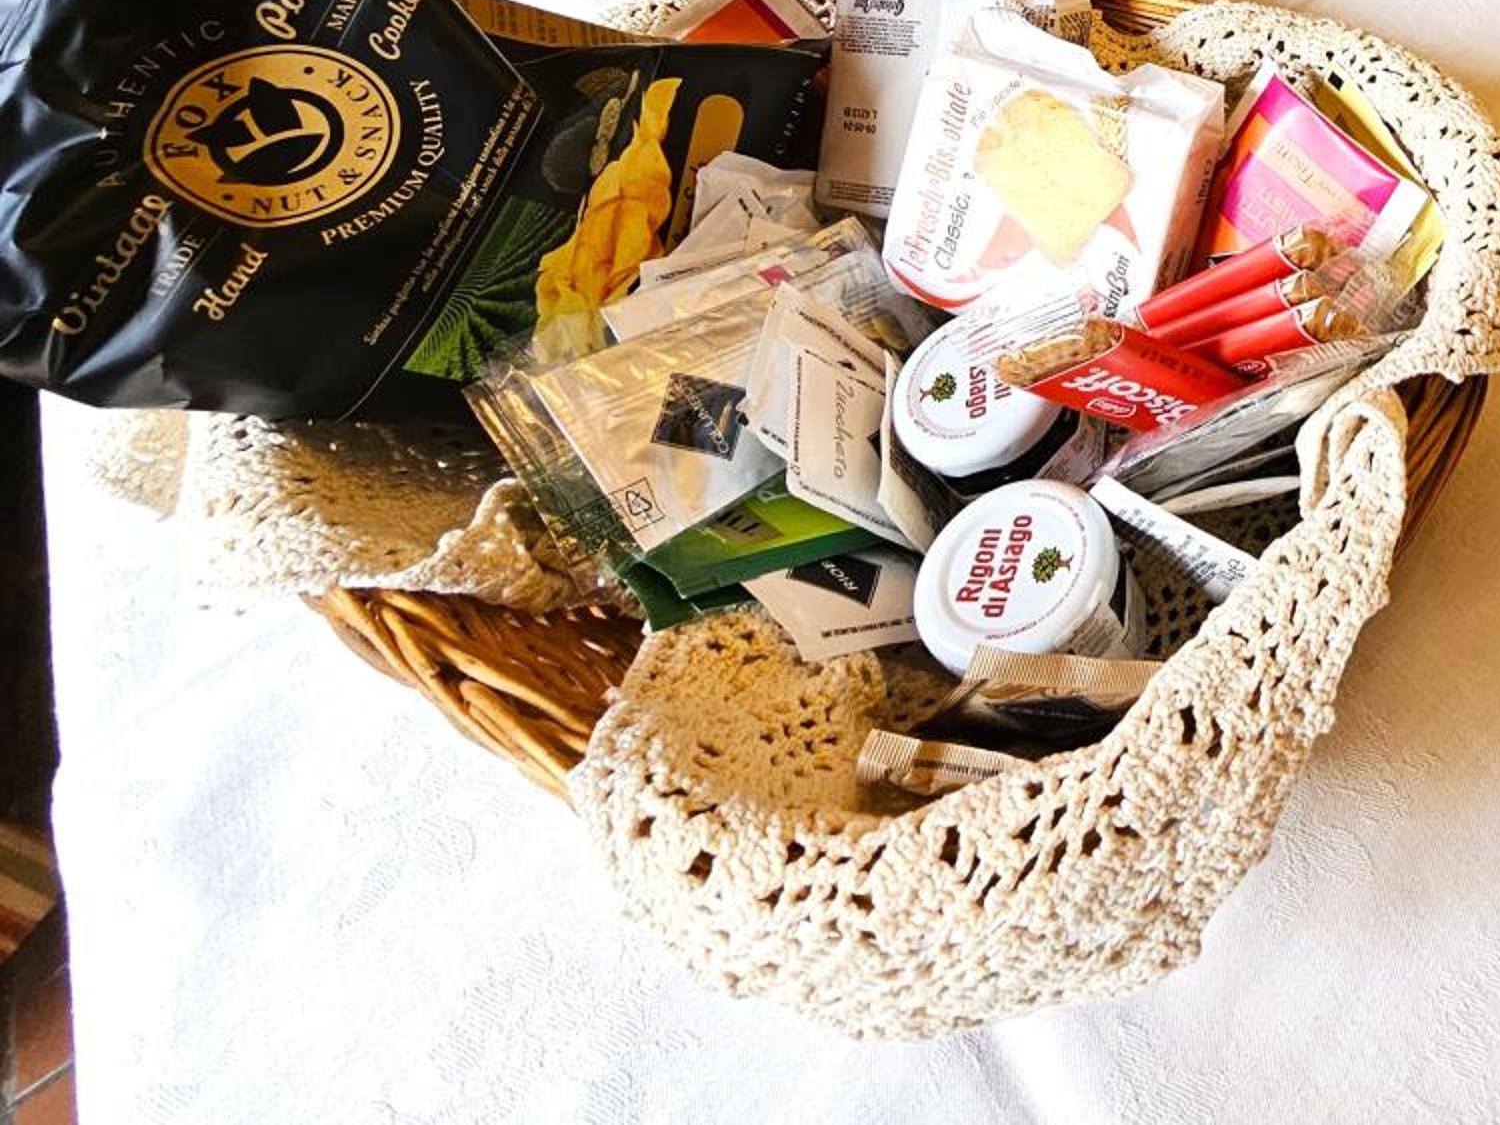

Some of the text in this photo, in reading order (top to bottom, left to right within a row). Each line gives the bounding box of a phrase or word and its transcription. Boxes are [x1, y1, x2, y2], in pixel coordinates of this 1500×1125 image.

[95, 18, 226, 190] AUTHENTIC
[163, 71, 244, 161] FOX
[252, 68, 386, 216] NUT & SNACK
[320, 79, 445, 246] PREMIUM QUALITY
[52, 194, 174, 335] Vintage
[152, 233, 206, 296] TRADE
[193, 242, 268, 322] Hand
[833, 378, 855, 479] Zucchero
[965, 366, 987, 419] siago
[1061, 366, 1199, 425] Biscoff
[955, 528, 1003, 604] Rigoni
[993, 514, 1033, 597] Asiago
[980, 594, 1007, 619] di
